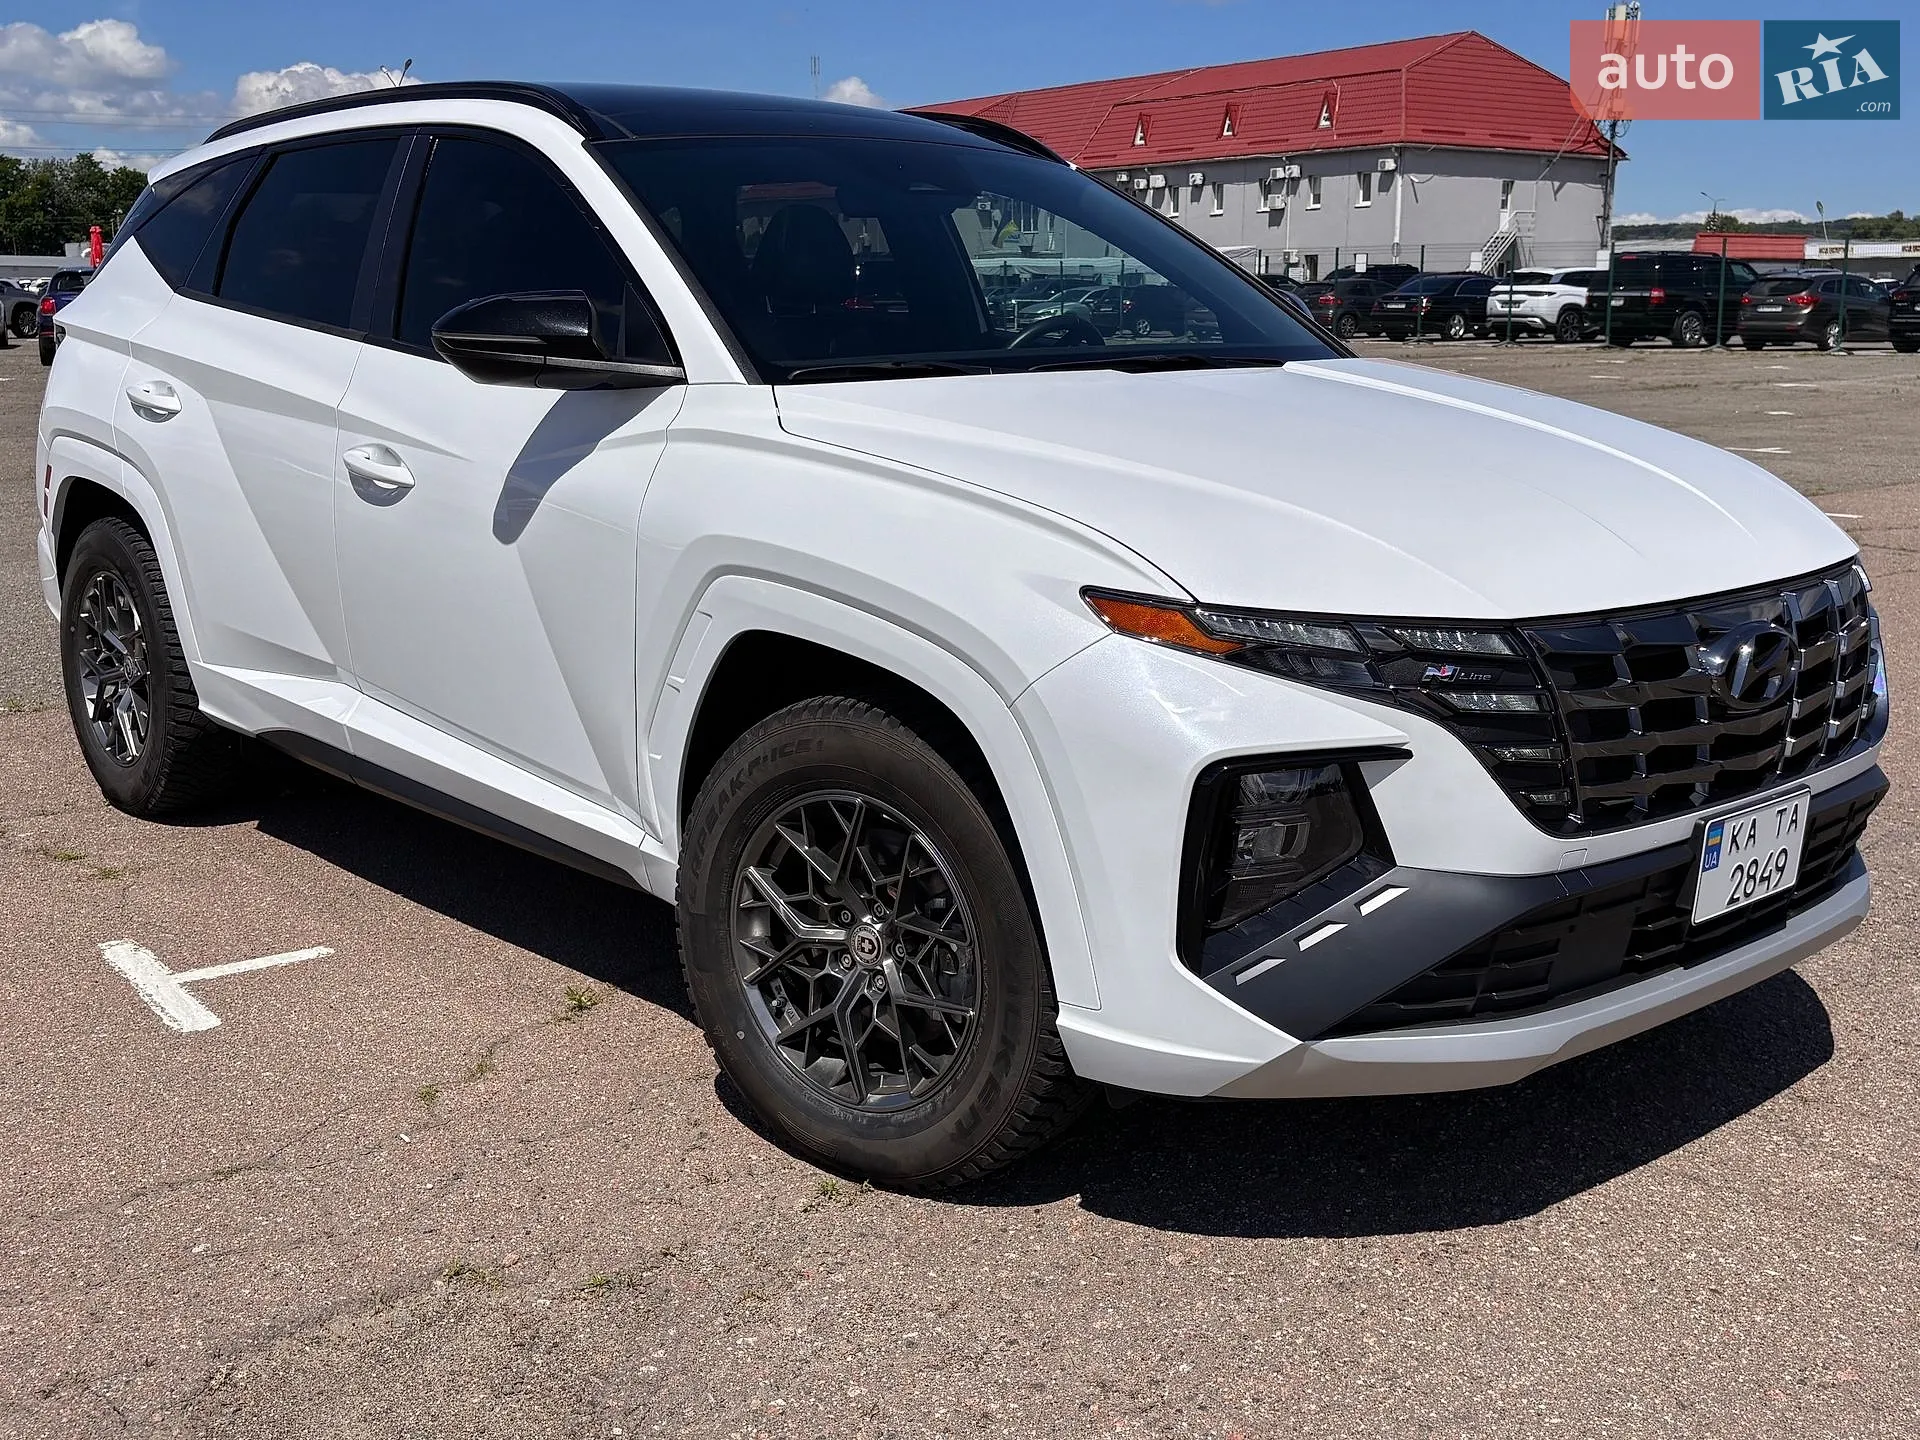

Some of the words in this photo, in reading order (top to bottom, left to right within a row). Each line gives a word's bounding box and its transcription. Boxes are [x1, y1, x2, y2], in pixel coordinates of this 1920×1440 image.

[1459, 672, 1492, 681] Line
[1728, 817, 1757, 855] KA
[1776, 802, 1799, 838] TA
[1704, 851, 1718, 868] UA
[1726, 846, 1788, 906] 2849
